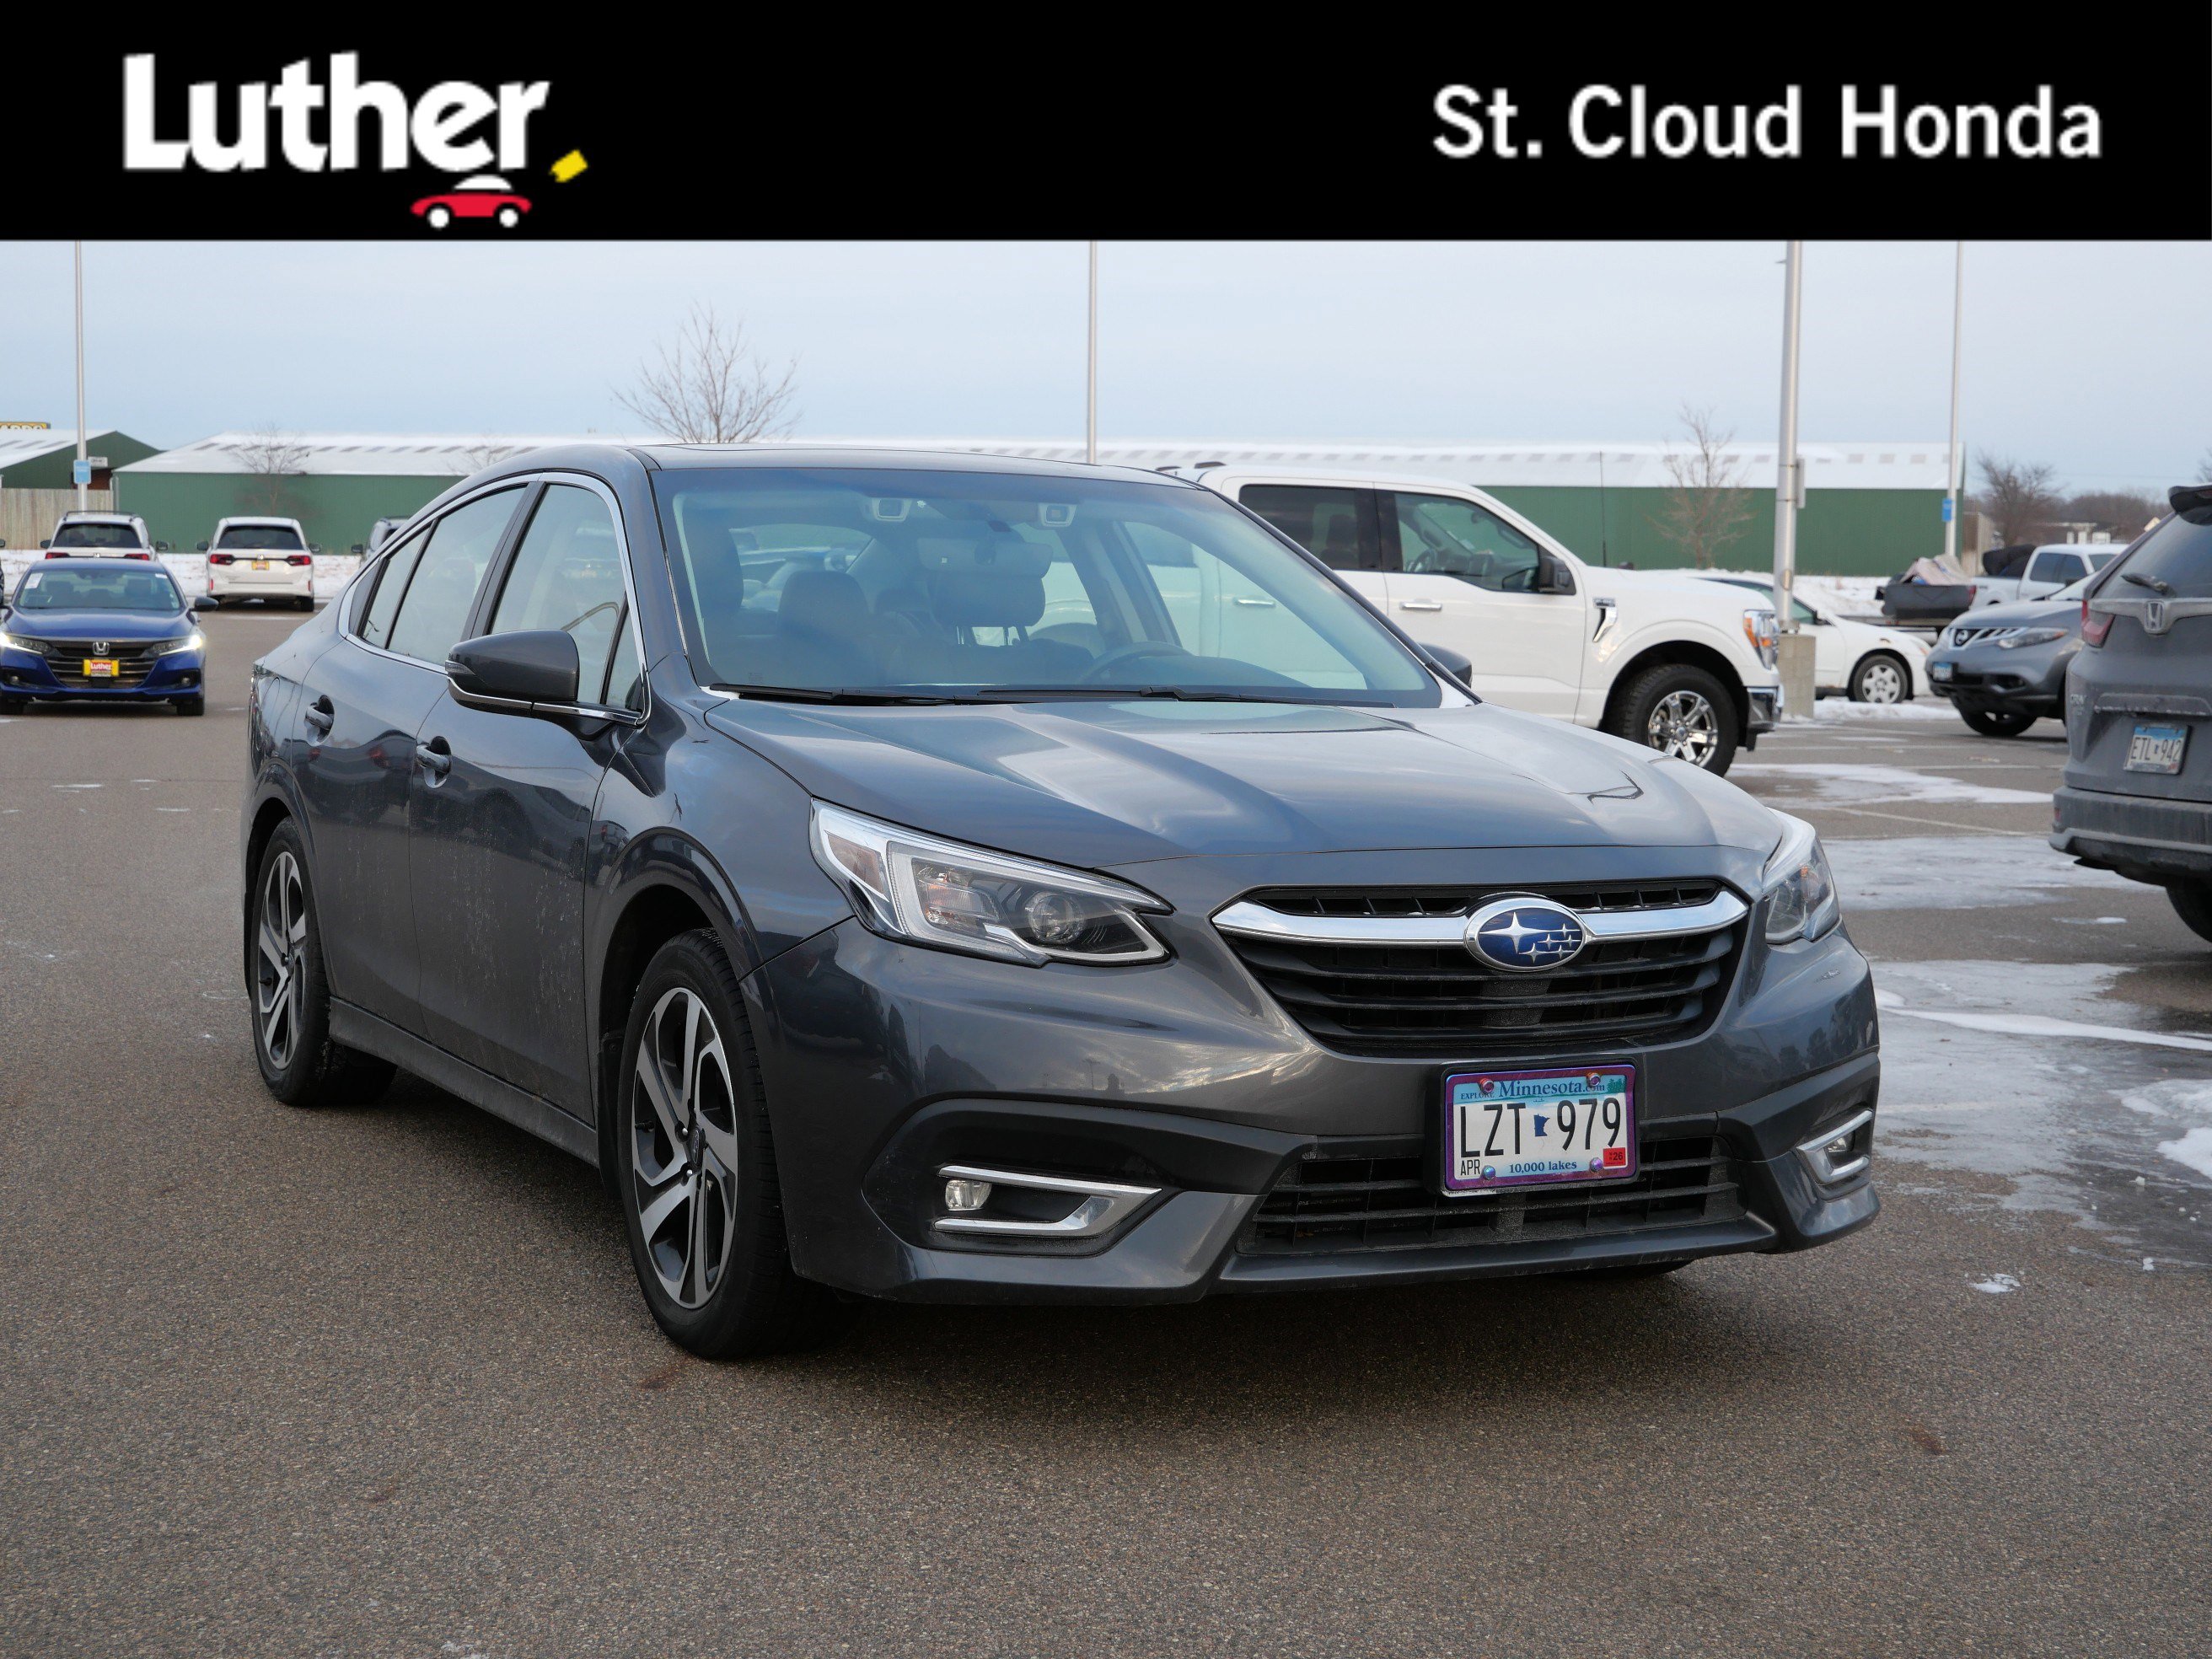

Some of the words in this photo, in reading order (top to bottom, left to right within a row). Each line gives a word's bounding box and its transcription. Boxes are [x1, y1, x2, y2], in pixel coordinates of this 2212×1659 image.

[2131, 737, 2150, 760] ETL
[1460, 1102, 1527, 1157] LZT
[1557, 1097, 1620, 1151] 979
[1613, 1152, 1624, 1161] 26
[1460, 1159, 1480, 1175] APR
[1510, 1162, 1545, 1173] 10,000
[1549, 1161, 1577, 1170] lakes
